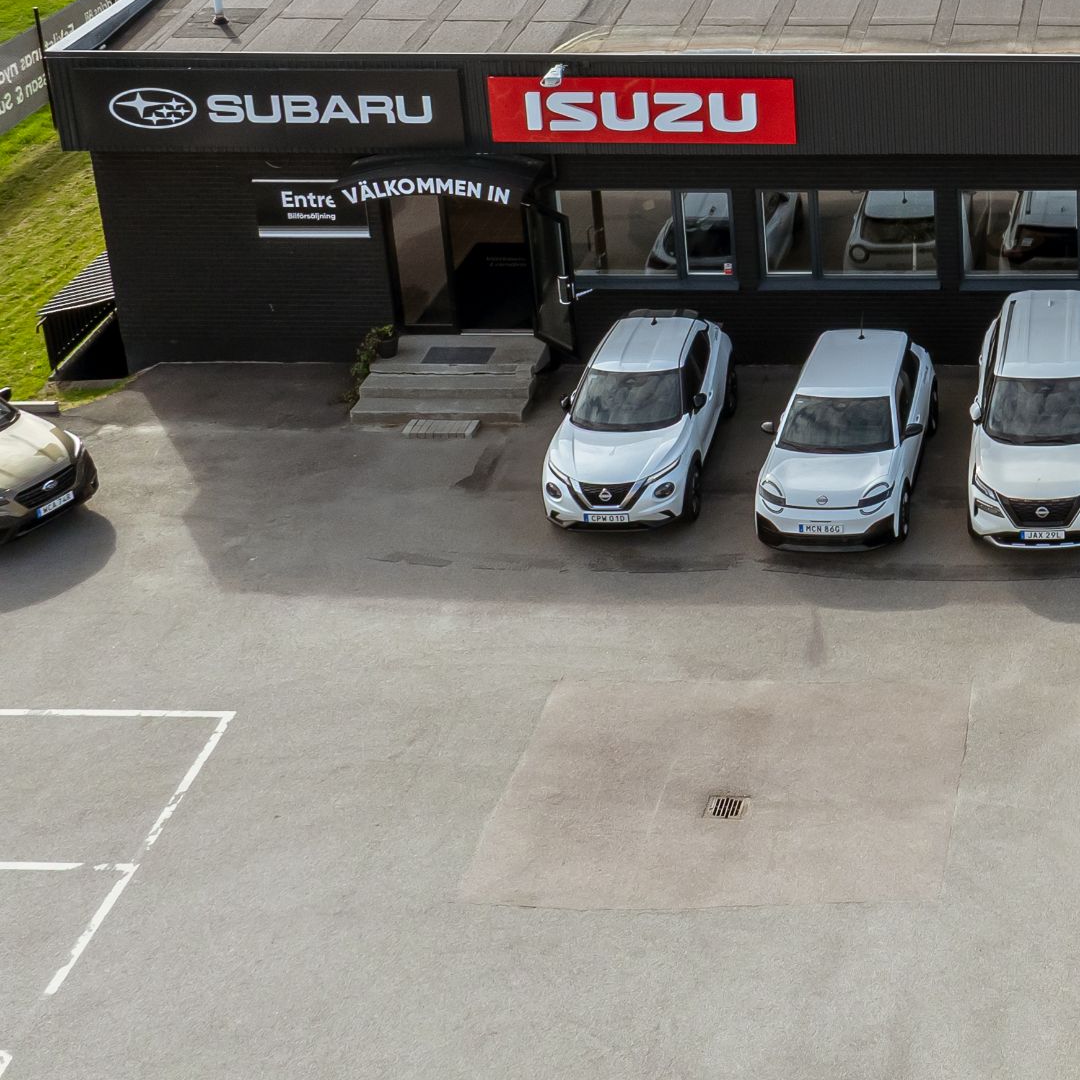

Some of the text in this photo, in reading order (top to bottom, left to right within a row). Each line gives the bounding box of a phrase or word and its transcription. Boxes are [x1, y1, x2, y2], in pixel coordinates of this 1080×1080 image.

[206, 94, 433, 125] SUBARU
[524, 91, 758, 133] ISUZU
[341, 177, 511, 205] VÄLKOMMEN IN
